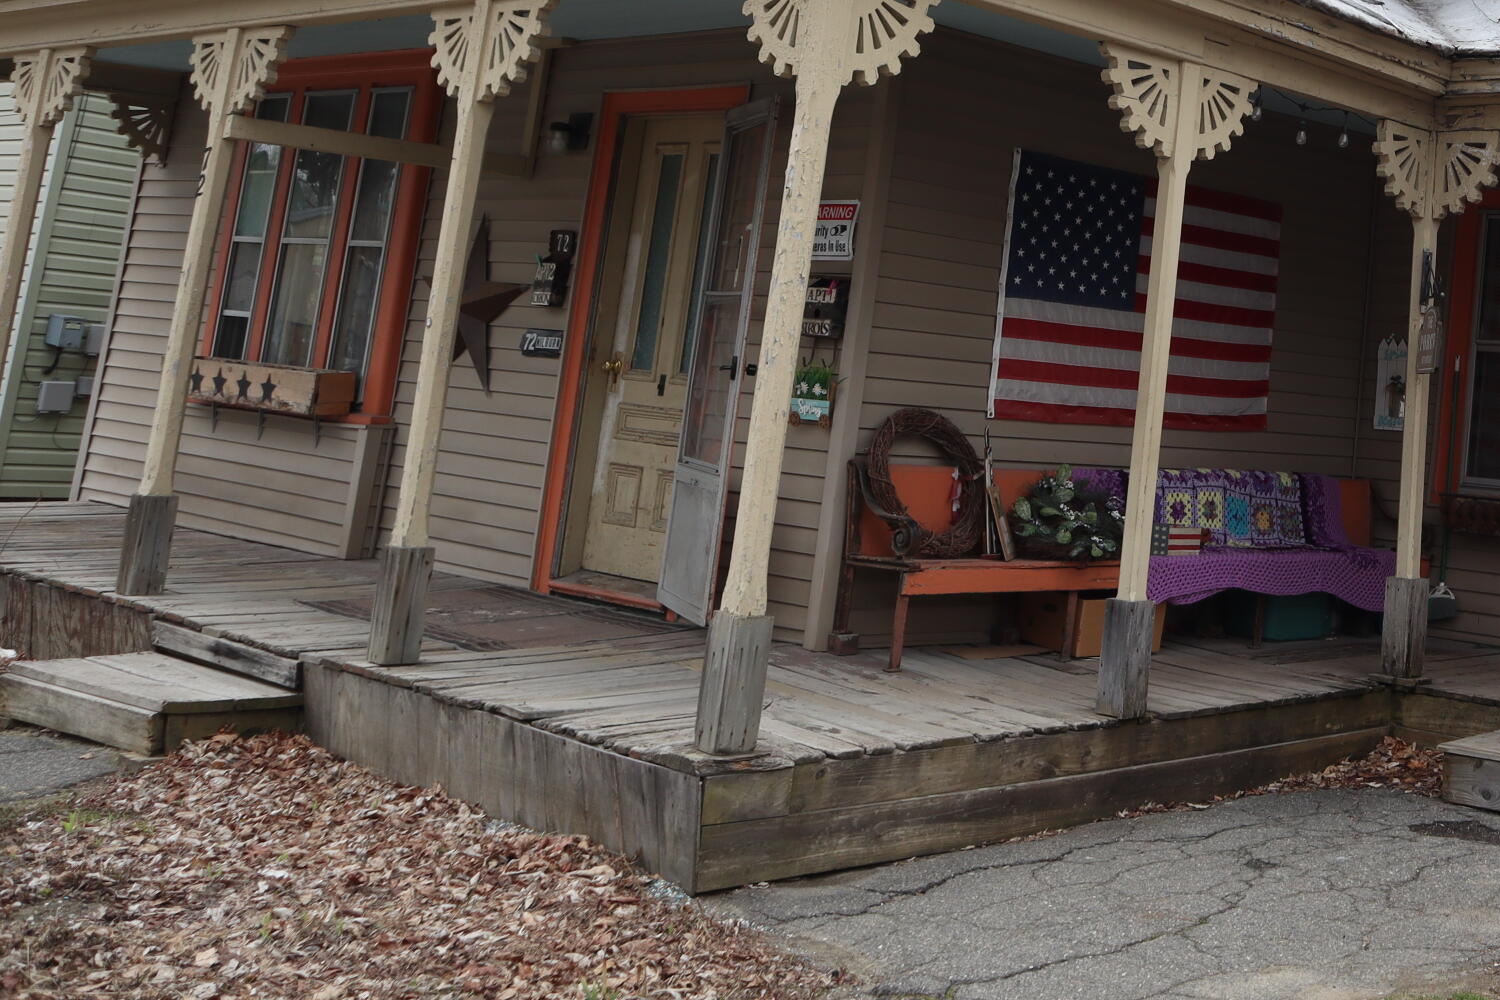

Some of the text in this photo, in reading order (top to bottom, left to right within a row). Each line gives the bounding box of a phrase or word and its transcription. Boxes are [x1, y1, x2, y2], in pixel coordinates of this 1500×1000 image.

[818, 206, 854, 219] ARNING
[557, 233, 570, 253] 72
[813, 242, 826, 252] eras
[836, 240, 846, 252] Use
[523, 332, 538, 351] 72
